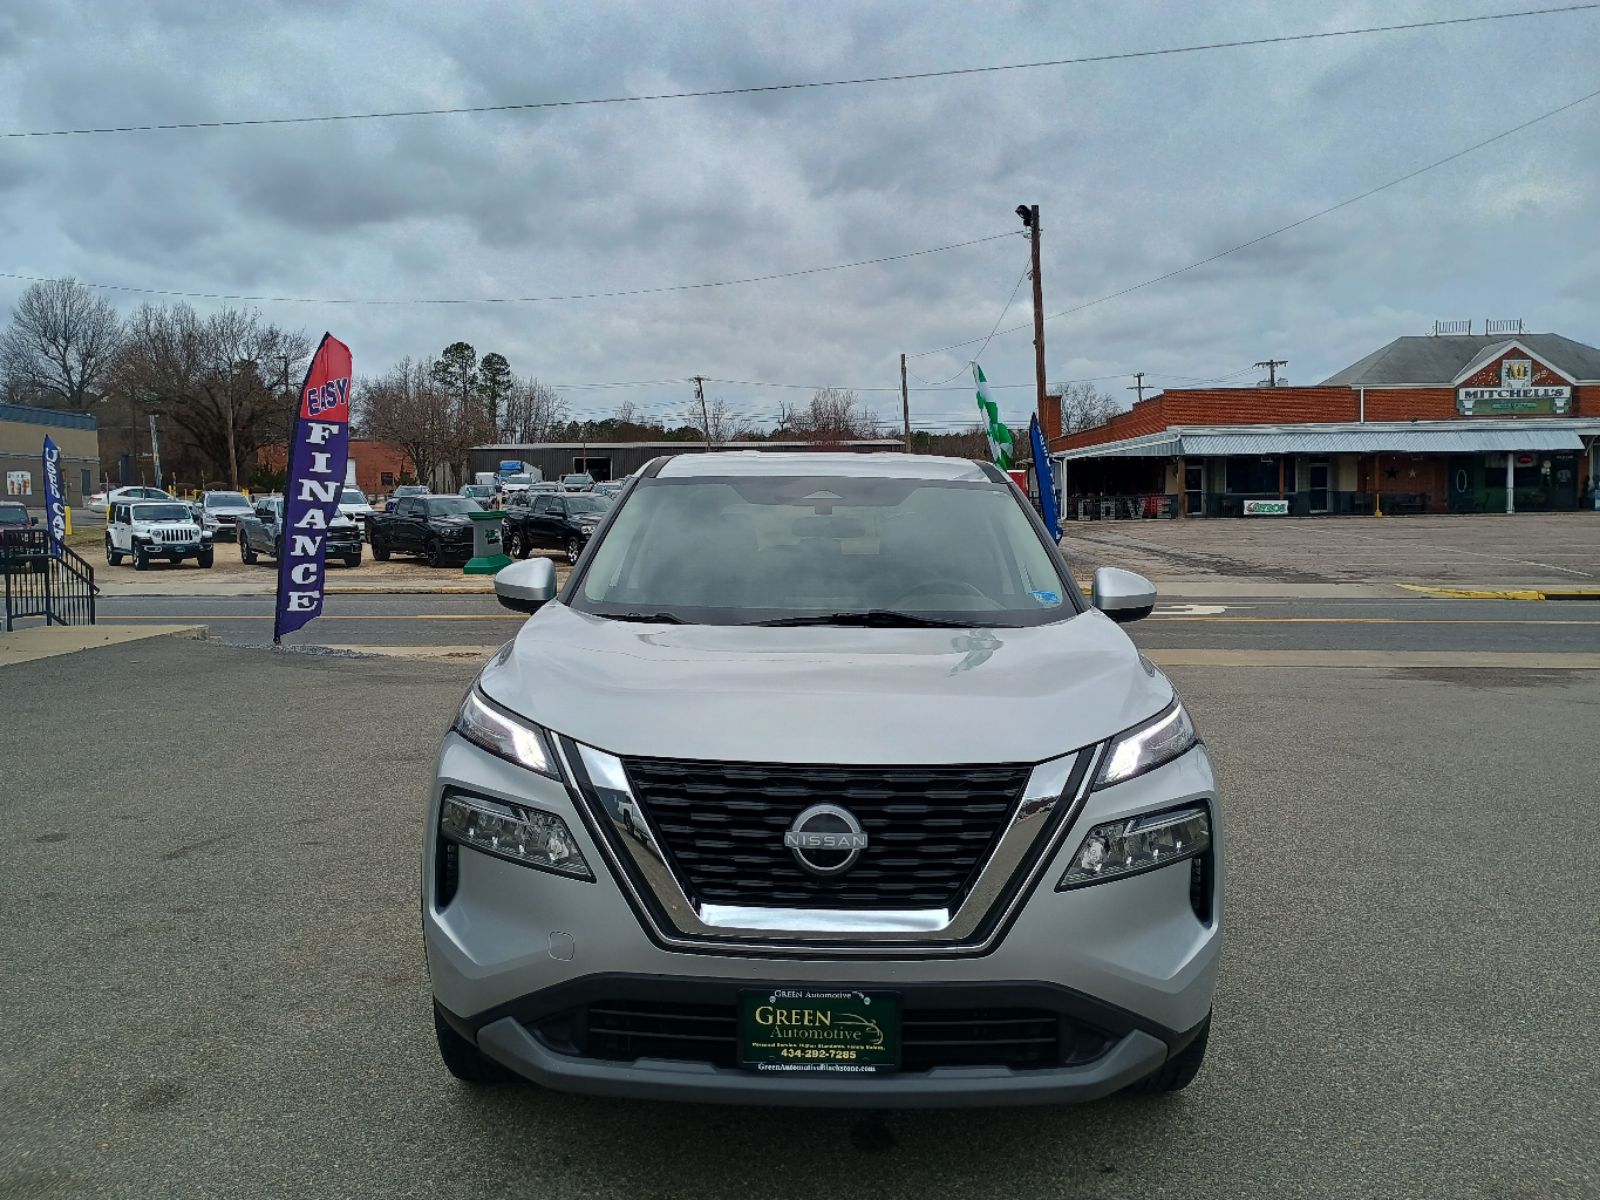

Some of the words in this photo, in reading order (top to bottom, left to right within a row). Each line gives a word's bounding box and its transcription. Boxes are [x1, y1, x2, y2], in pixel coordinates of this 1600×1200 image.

[307, 378, 348, 417] EASY
[1464, 388, 1564, 399] MITCHELL'S
[45, 447, 61, 499] USED
[287, 422, 340, 612] FINANCE
[787, 835, 865, 847] NISSAN
[774, 989, 803, 998] GREEN
[805, 991, 852, 999] Automotive
[755, 1006, 831, 1026] GREEN
[770, 1025, 862, 1040] Automotive
